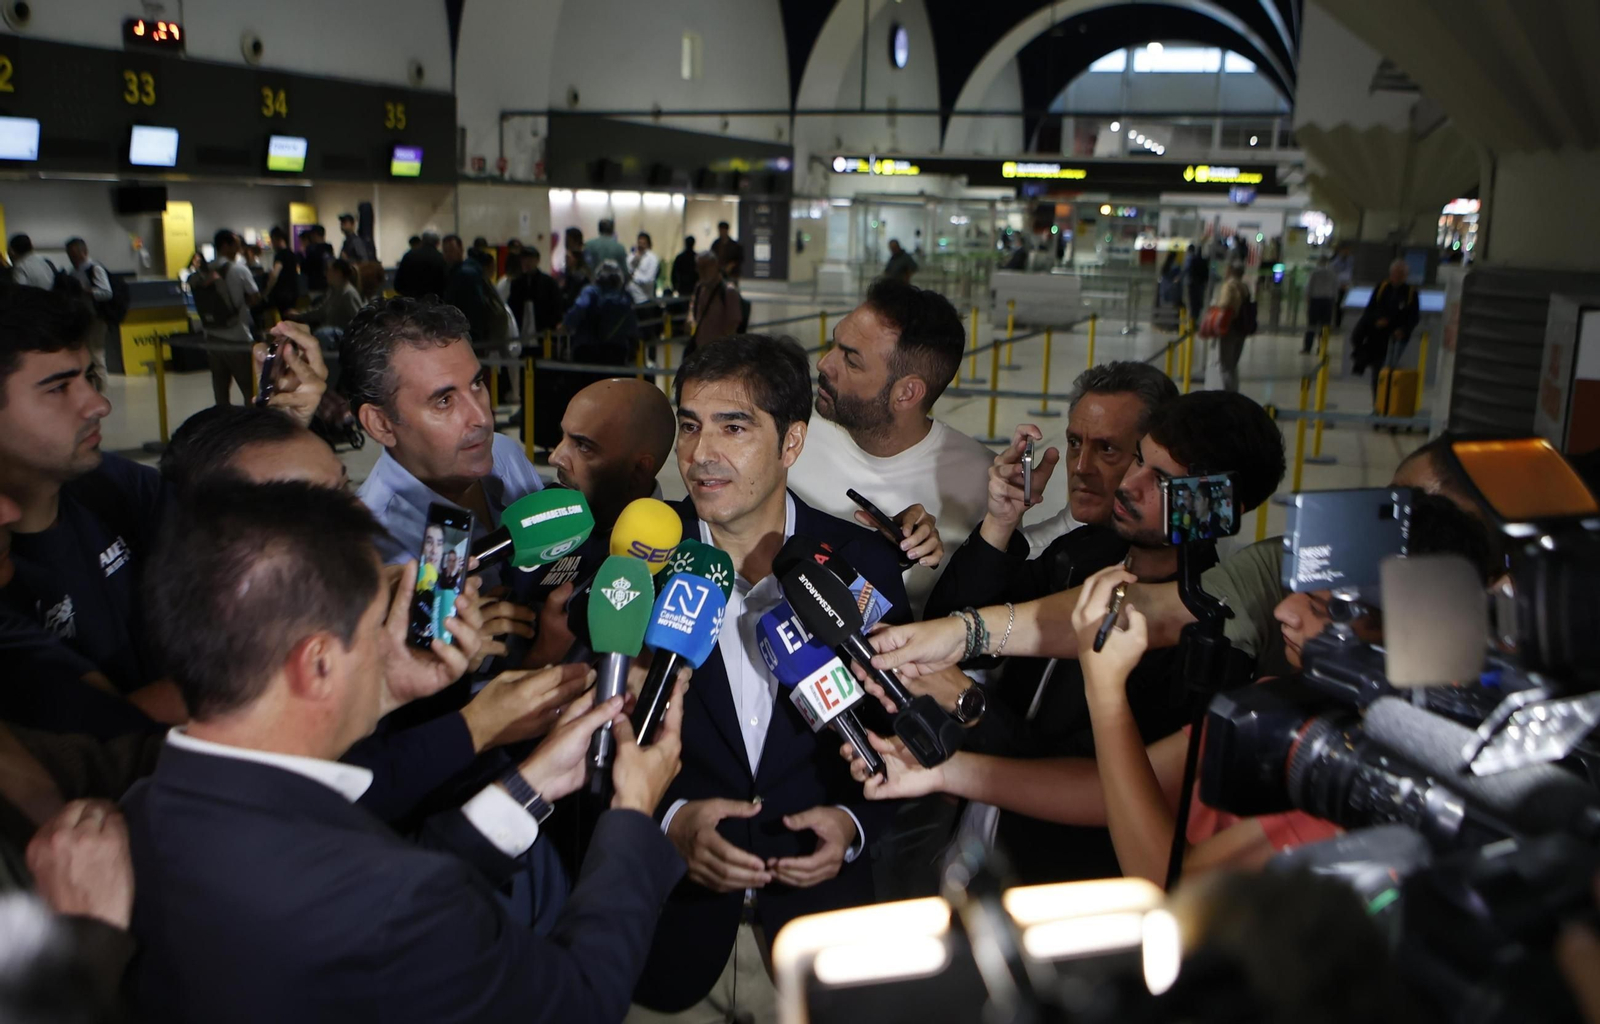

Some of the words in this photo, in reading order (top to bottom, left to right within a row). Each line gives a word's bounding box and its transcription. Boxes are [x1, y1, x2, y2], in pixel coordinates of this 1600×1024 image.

[123, 69, 156, 106] 33
[261, 86, 288, 119] 34
[384, 101, 407, 131] 35
[657, 617, 693, 635] NOTICIAS
[814, 666, 854, 711] ED
